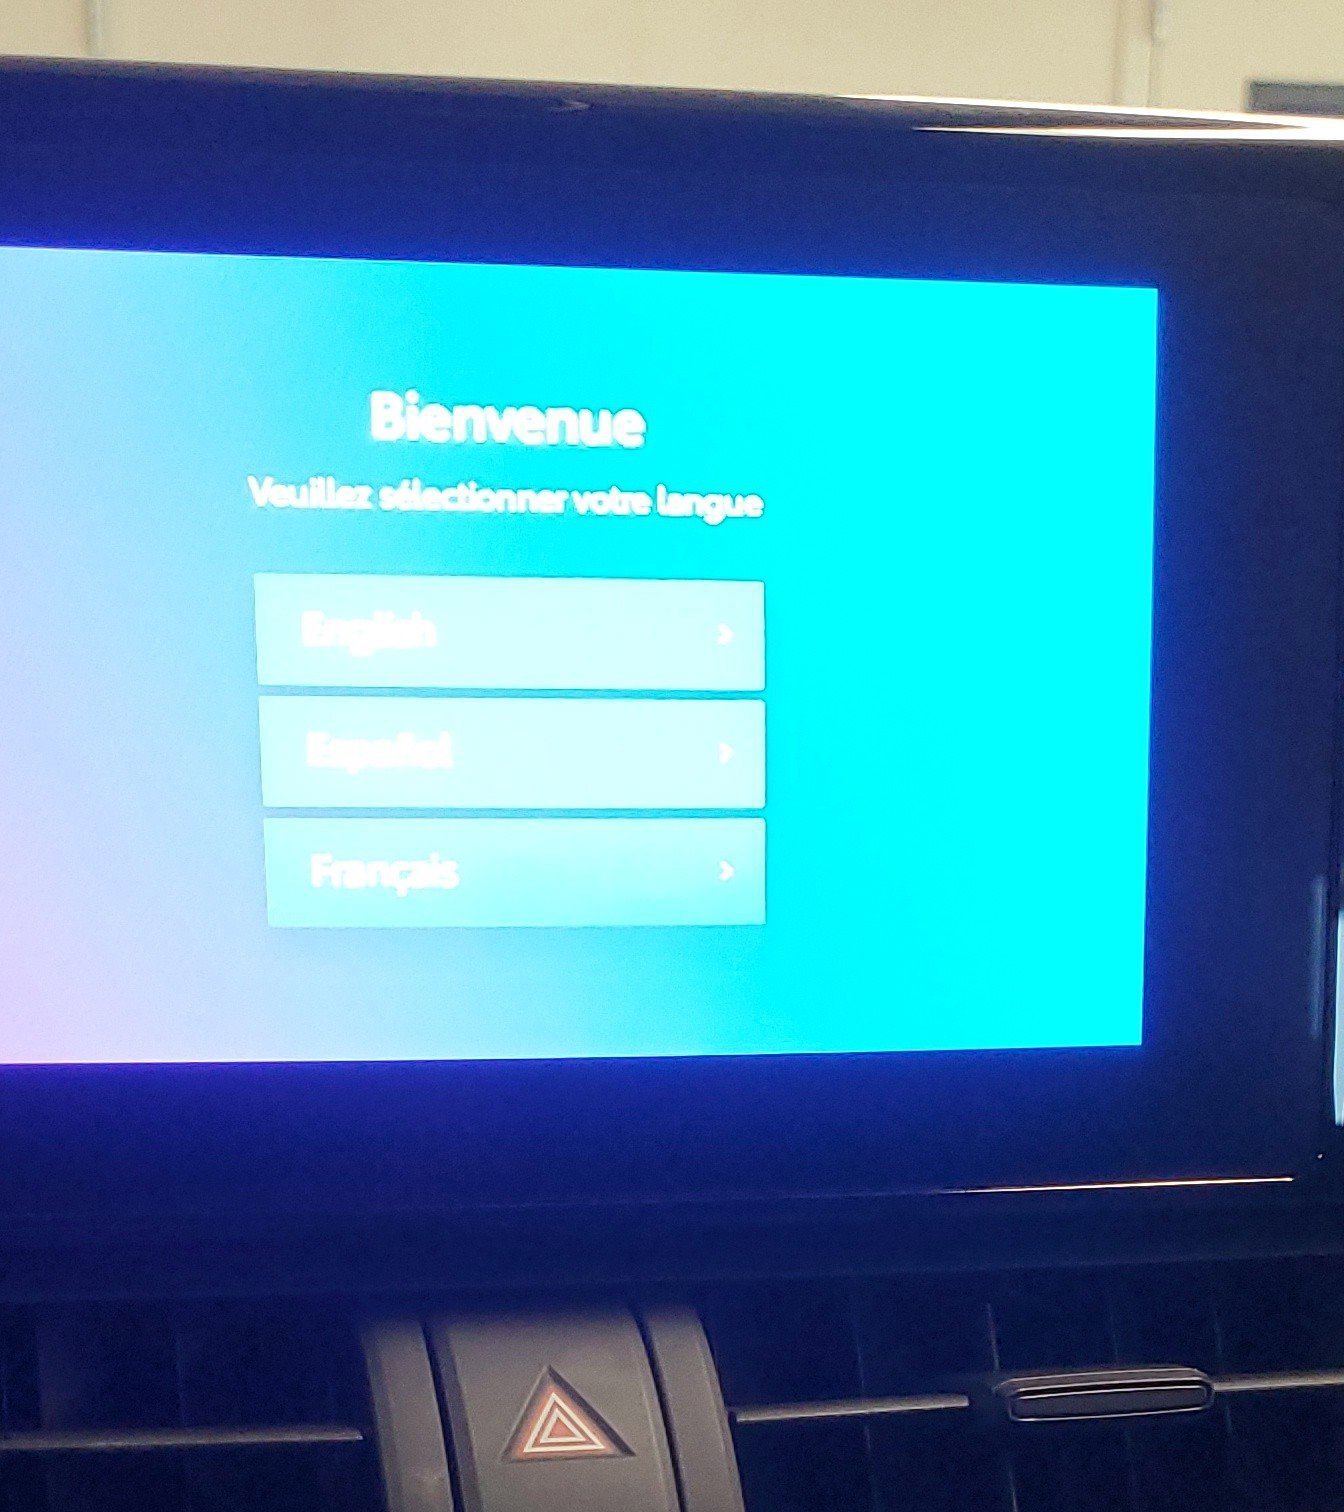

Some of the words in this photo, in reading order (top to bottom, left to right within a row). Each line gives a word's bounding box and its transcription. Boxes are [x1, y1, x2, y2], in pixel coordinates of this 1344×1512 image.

[370, 388, 647, 449] Bienvenue
[247, 475, 372, 510] Veuillez
[378, 476, 569, 516] sélectionner
[571, 486, 651, 517] votre
[657, 483, 765, 526] langue
[301, 611, 437, 658] English
[311, 852, 460, 897] Français
